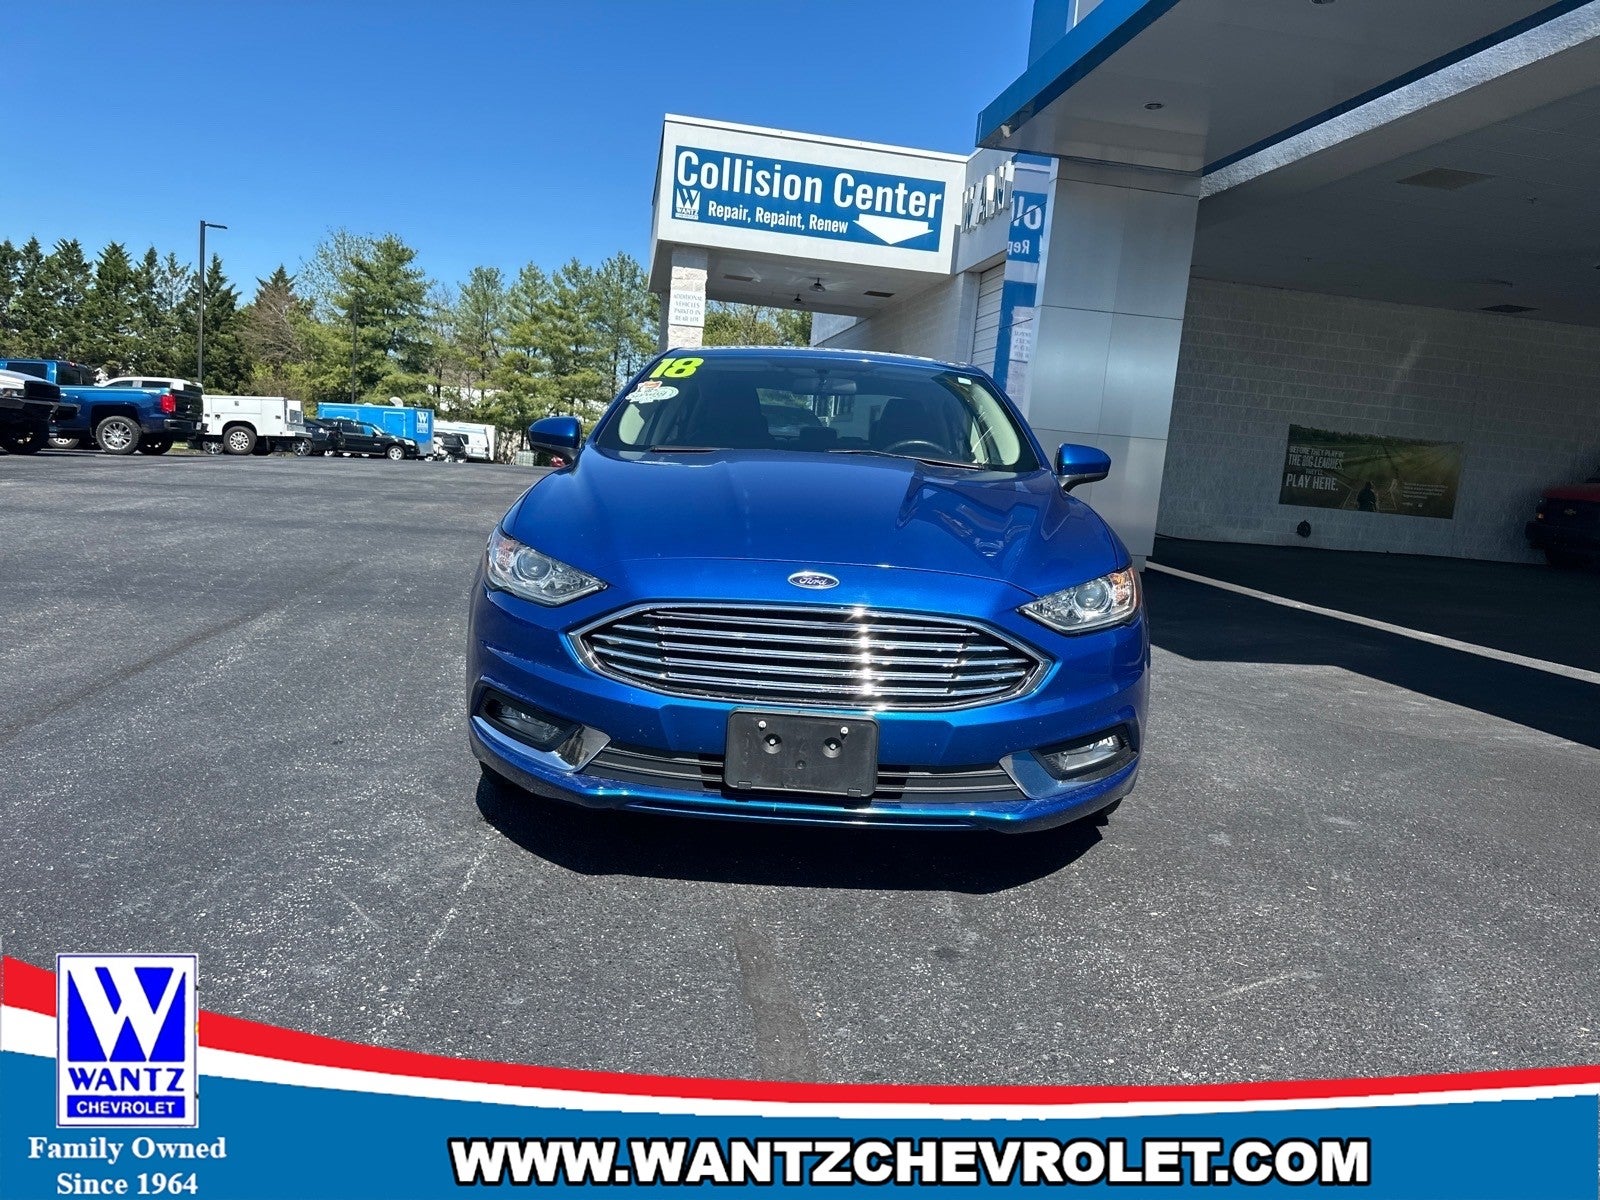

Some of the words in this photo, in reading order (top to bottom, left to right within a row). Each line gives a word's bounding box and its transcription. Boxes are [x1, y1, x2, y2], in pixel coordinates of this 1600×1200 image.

[677, 151, 822, 204] Collision
[833, 172, 942, 218] Center
[708, 201, 751, 223] Repair,
[755, 207, 805, 230] Repaint,
[809, 214, 849, 234] Renew
[649, 357, 704, 378] 18
[1288, 454, 1301, 466] THE
[1286, 473, 1310, 488] PLAY
[1312, 476, 1339, 491] HERE.
